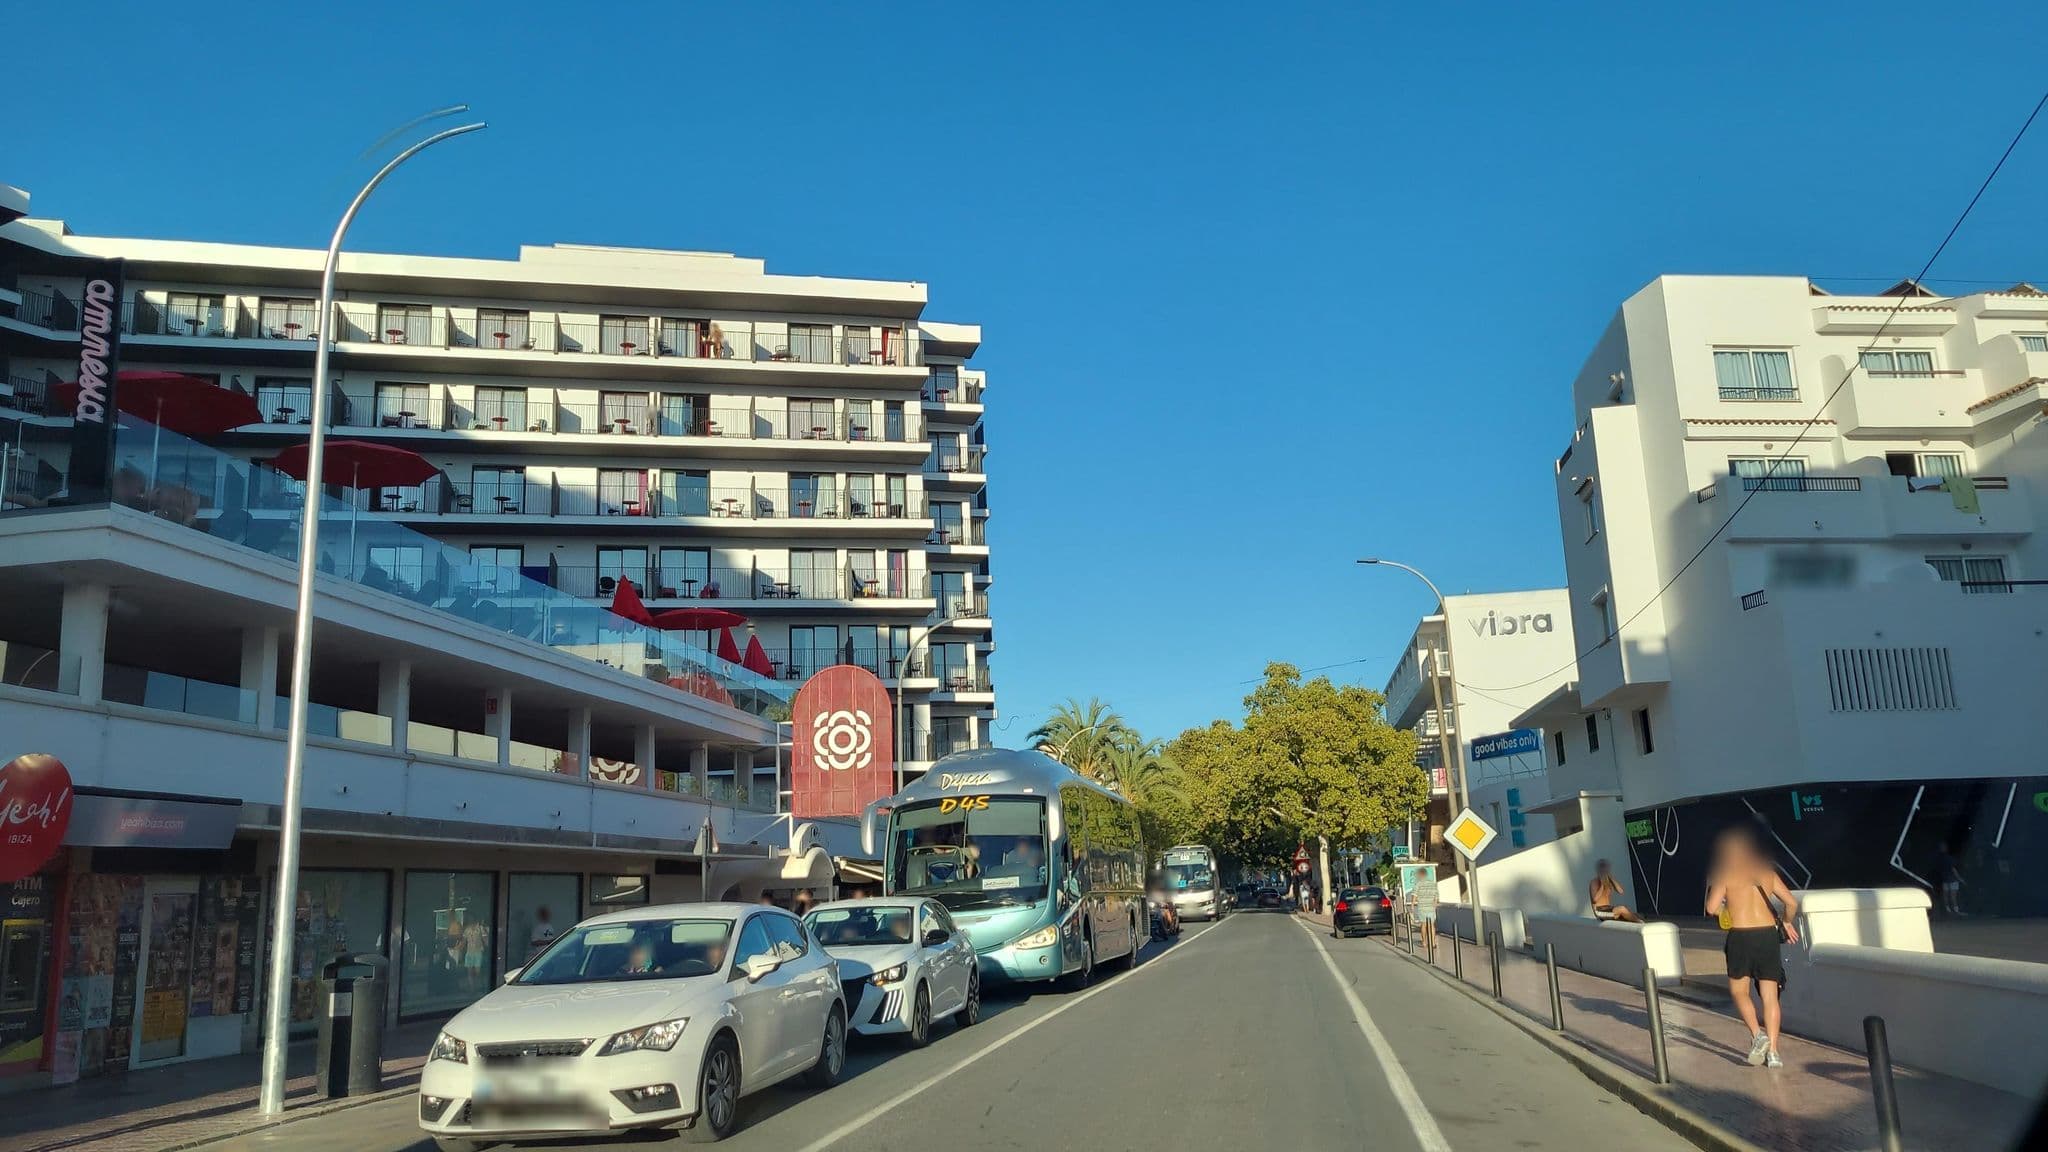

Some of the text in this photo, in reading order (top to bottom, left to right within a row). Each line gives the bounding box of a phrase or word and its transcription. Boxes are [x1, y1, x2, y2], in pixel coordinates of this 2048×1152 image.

[77, 279, 115, 423] amnesia
[1467, 610, 1553, 638] vibra
[1474, 732, 1537, 758] good vibes only
[8, 834, 33, 844] IBIZA
[14, 876, 42, 890] ATM
[11, 896, 41, 908] Cajero
